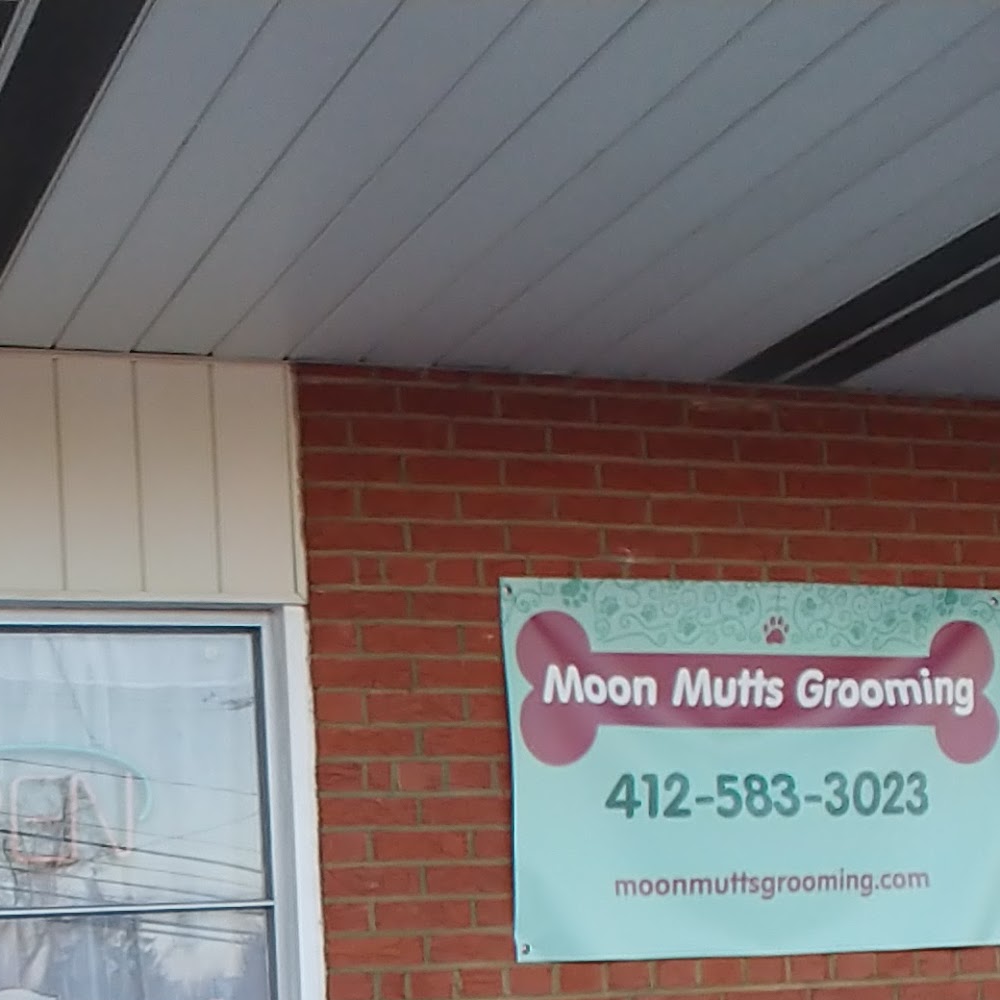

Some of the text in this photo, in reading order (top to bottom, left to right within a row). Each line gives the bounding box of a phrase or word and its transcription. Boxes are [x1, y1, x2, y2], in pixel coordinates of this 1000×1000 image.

[543, 663, 975, 717] Moon Mutts Grooming
[604, 770, 930, 820] 412-583-3023
[614, 867, 931, 901] moonmuttsgrooming.com
